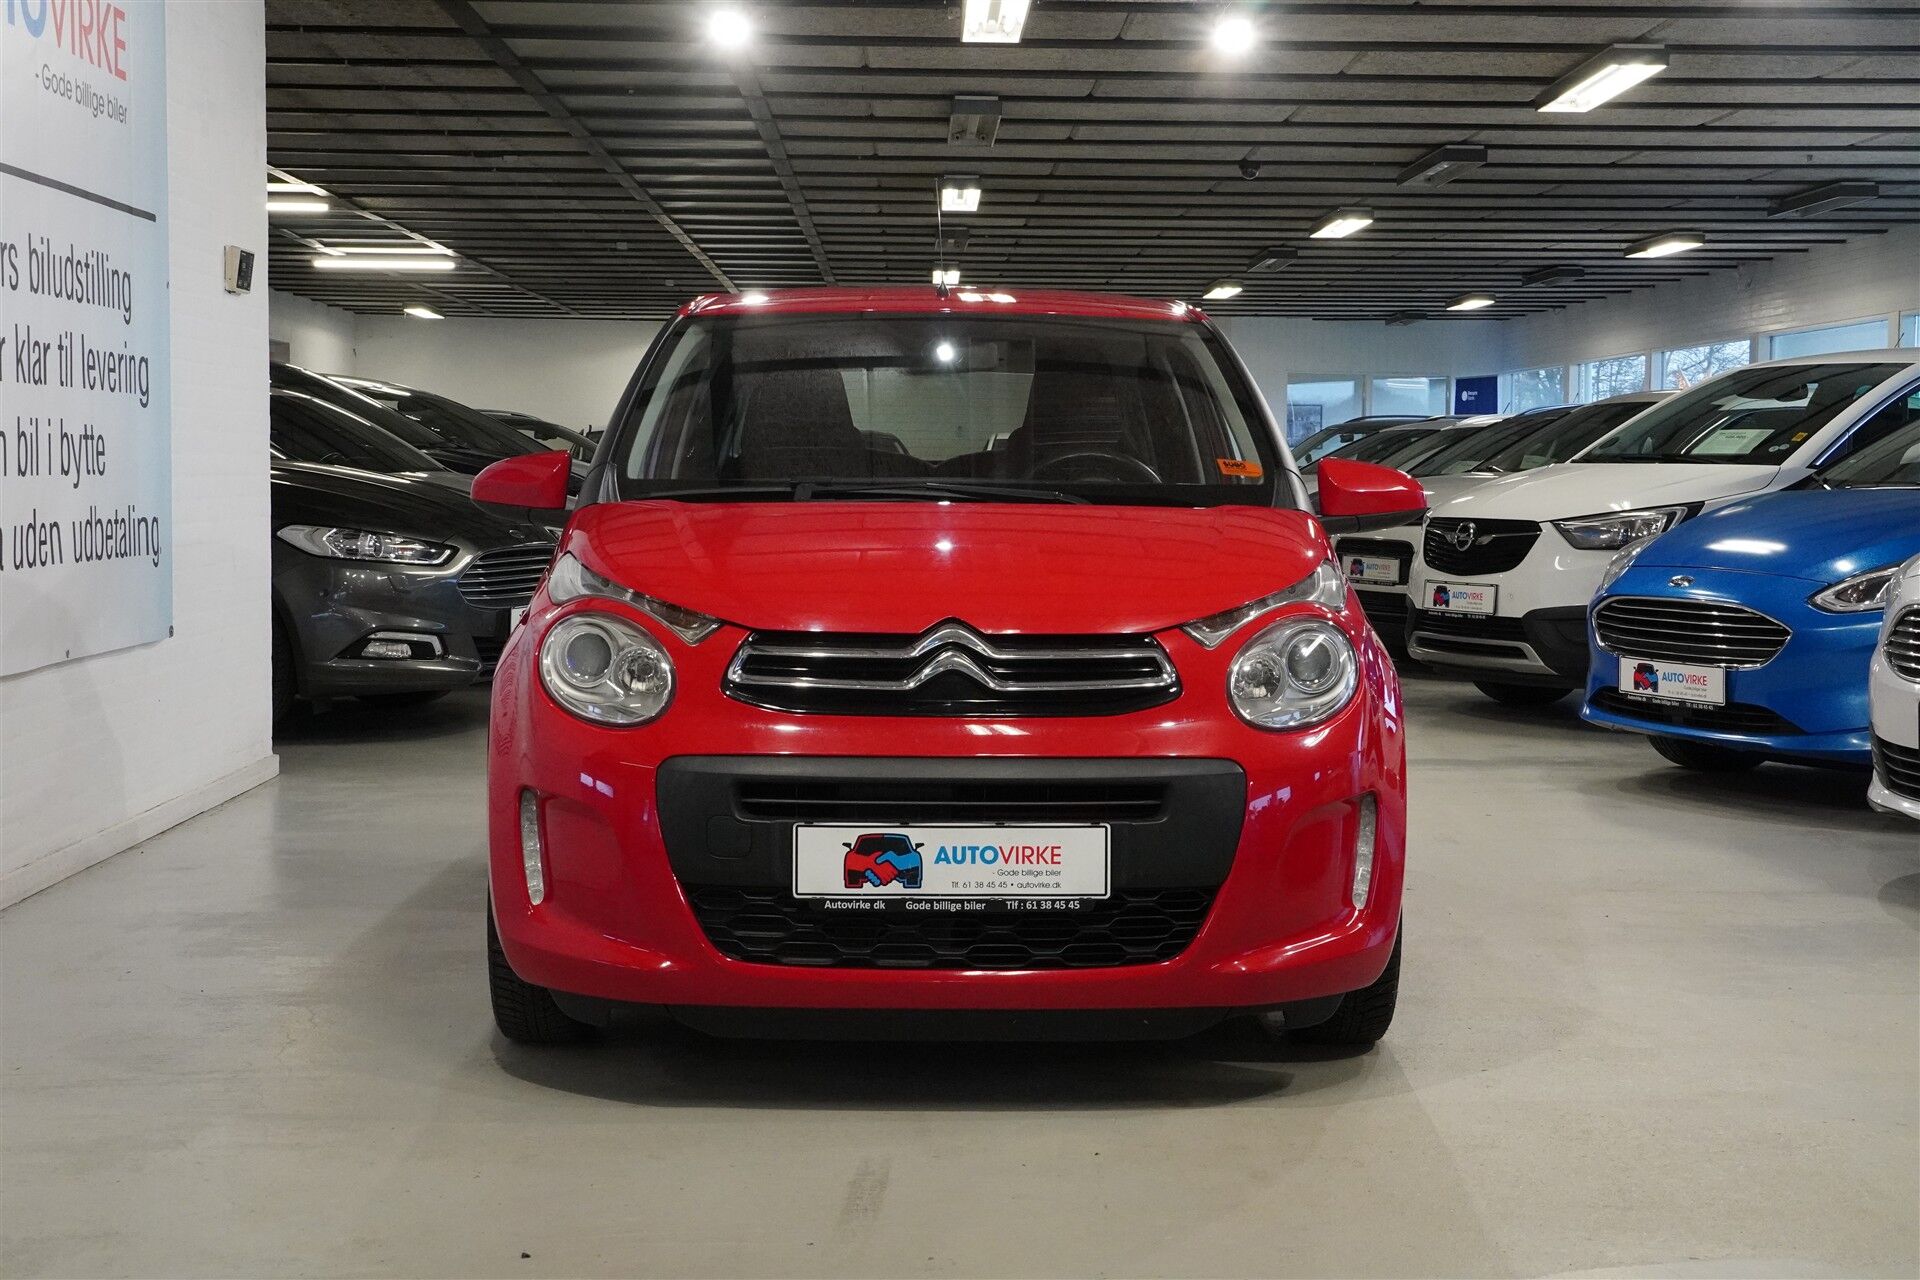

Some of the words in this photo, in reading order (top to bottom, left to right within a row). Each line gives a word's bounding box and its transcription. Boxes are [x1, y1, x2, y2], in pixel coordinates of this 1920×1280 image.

[42, 64, 72, 100] Gode
[75, 78, 105, 119] billige
[107, 93, 127, 124] biler
[28, 232, 132, 325] biludstilling
[15, 323, 51, 386] klar
[57, 330, 73, 388] til
[81, 333, 149, 408] levering
[17, 415, 39, 478] bil
[48, 417, 52, 476] i
[60, 417, 106, 489] bytte
[13, 508, 63, 571] uden
[1662, 671, 1708, 686] AUTOVIRKE
[934, 845, 1062, 865] AUTOVIRKE
[997, 868, 1019, 877] Gode
[1021, 868, 1044, 878] billige
[1045, 868, 1062, 877] biler
[962, 881, 971, 889] 61
[974, 881, 984, 889] 38
[986, 881, 996, 889] 45
[998, 881, 1008, 889] 45
[824, 900, 871, 910] Autovirke
[873, 900, 886, 910] dk
[905, 900, 932, 910] Gode
[933, 900, 962, 912] billige
[964, 900, 986, 910] biler
[1026, 900, 1038, 910] 61
[1040, 900, 1052, 910] 38
[1054, 900, 1066, 910] 45
[1068, 900, 1080, 910] 45
